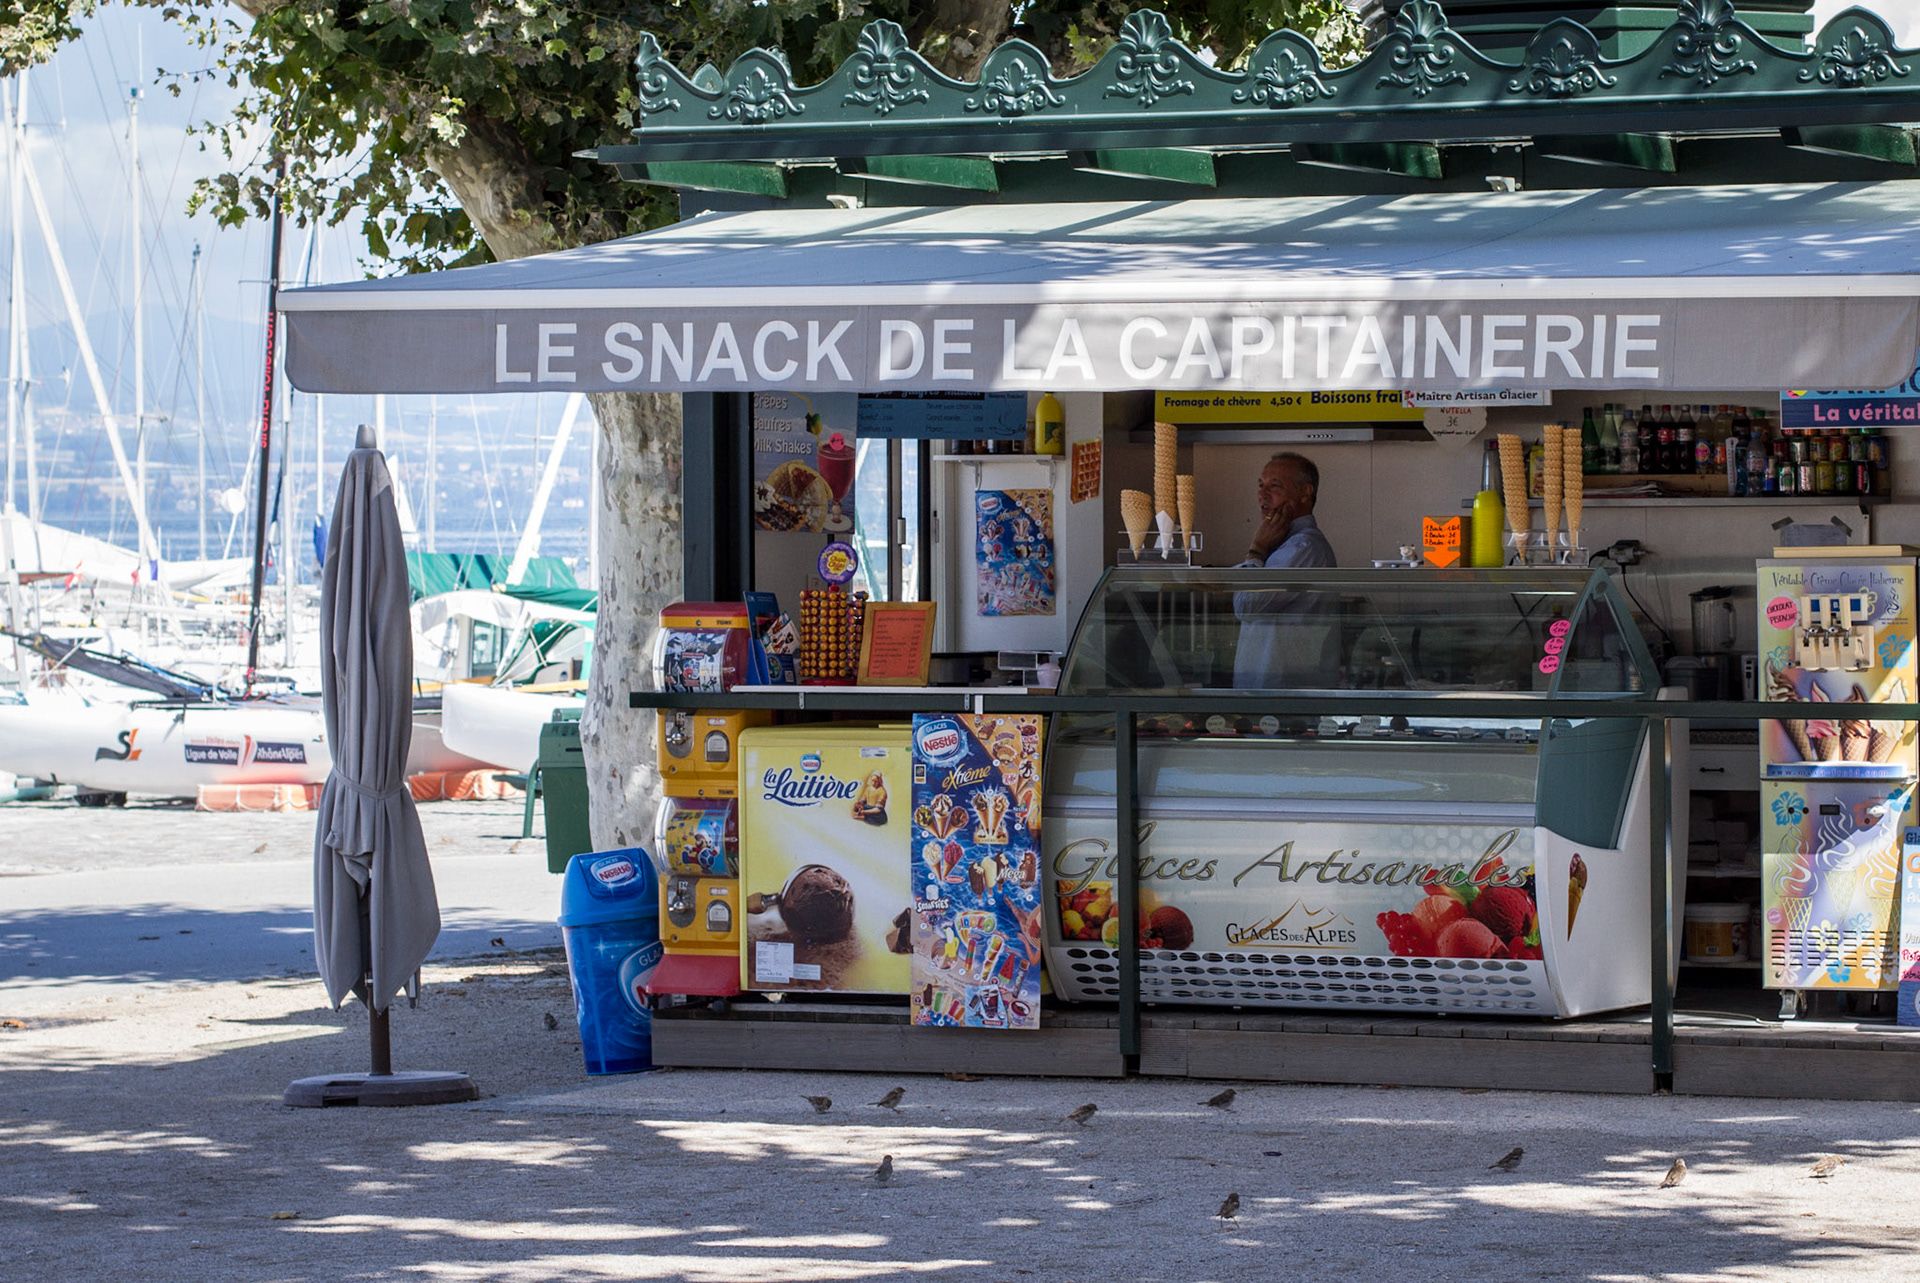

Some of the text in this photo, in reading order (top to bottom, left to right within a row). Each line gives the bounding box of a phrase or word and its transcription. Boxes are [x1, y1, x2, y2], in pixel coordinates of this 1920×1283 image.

[496, 314, 1661, 383] LE SNACK DE LA CAPITAINERIE
[1164, 397, 1209, 408] Fromage
[1212, 396, 1225, 406] de
[1227, 396, 1261, 406] chèvre
[1270, 397, 1293, 407] 4,50
[1310, 391, 1372, 404] Boissons
[1416, 389, 1538, 401] Maître Artisan Glacier
[1813, 404, 1840, 421] La
[775, 438, 812, 454] Shakes
[1772, 572, 1808, 587] Véritable
[1810, 571, 1837, 586] Crème
[1869, 571, 1905, 587] Italienne
[186, 749, 238, 761] Ligue de Voile
[764, 768, 859, 806] Laitière
[1905, 832, 1920, 843] Gl
[1232, 827, 1533, 888] Artisanales
[996, 868, 1026, 883] Mega
[1226, 923, 1357, 945] GLACES DES ALPES
